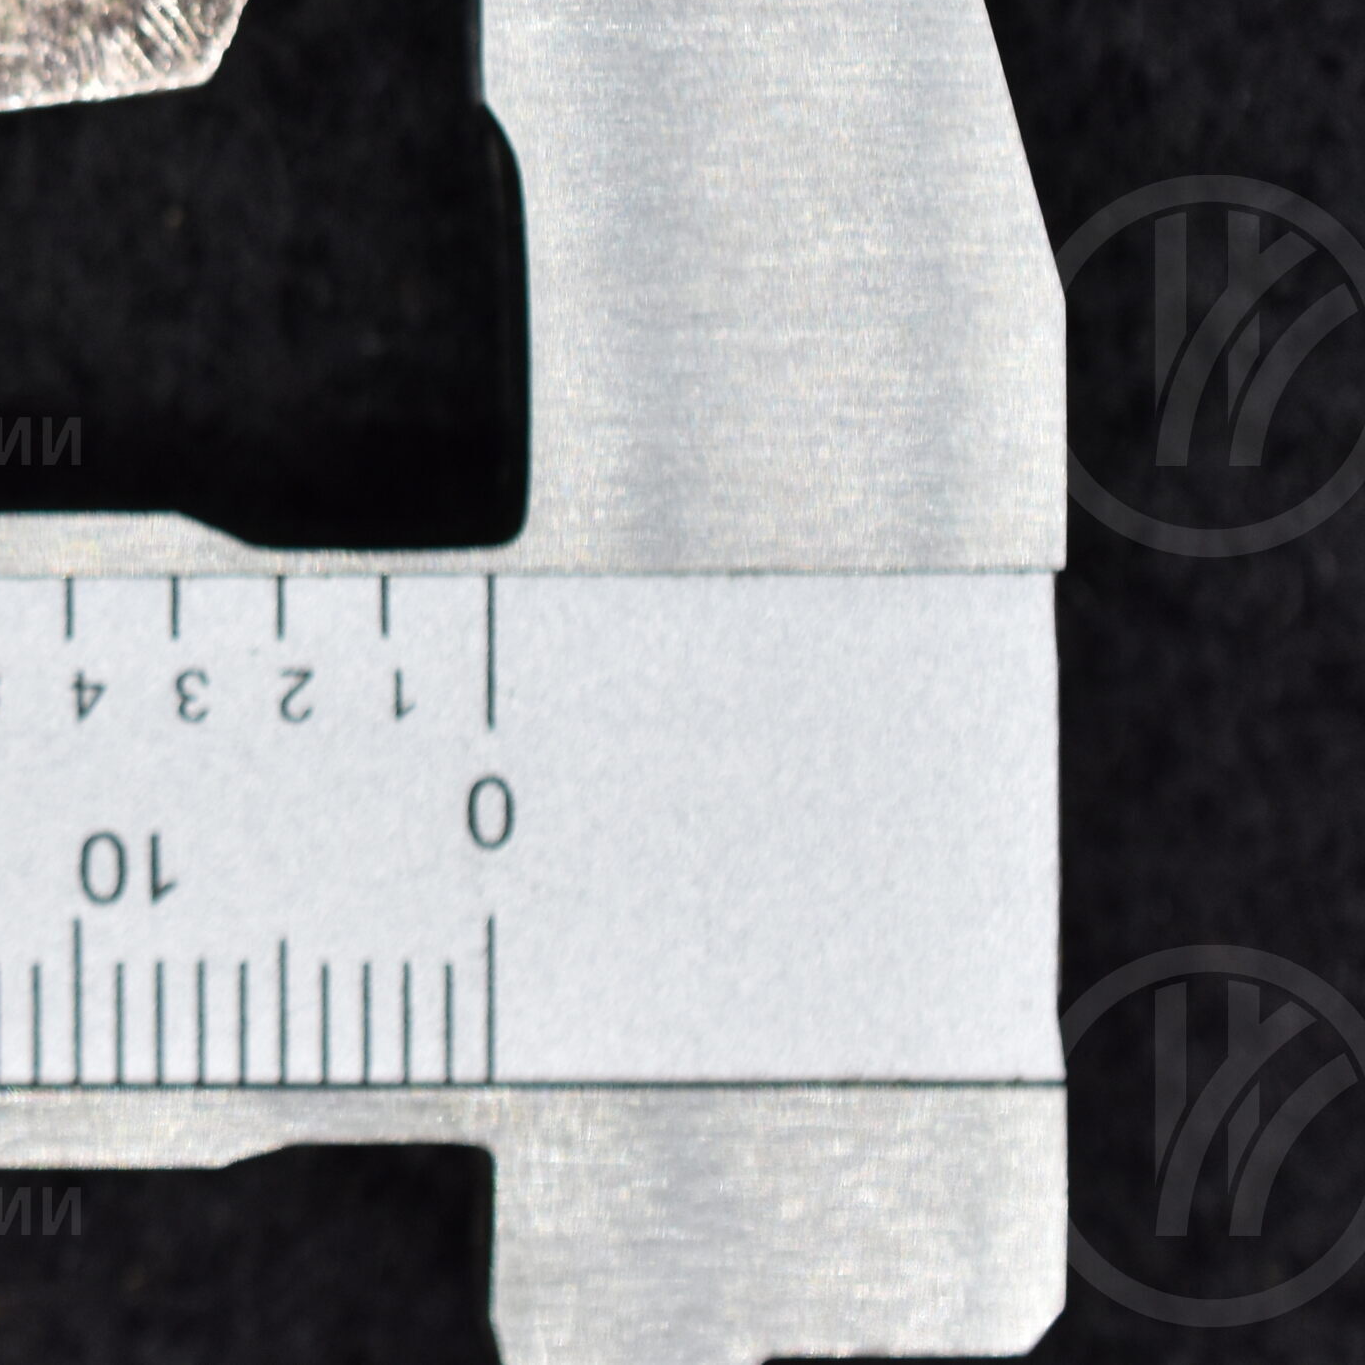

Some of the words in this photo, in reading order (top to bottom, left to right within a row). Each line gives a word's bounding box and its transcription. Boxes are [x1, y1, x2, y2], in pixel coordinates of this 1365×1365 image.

[70, 669, 107, 723] 4
[173, 668, 209, 723] 3
[278, 668, 314, 723] 2
[391, 668, 415, 723] 1
[465, 774, 516, 851] 0
[77, 830, 177, 907] 10
